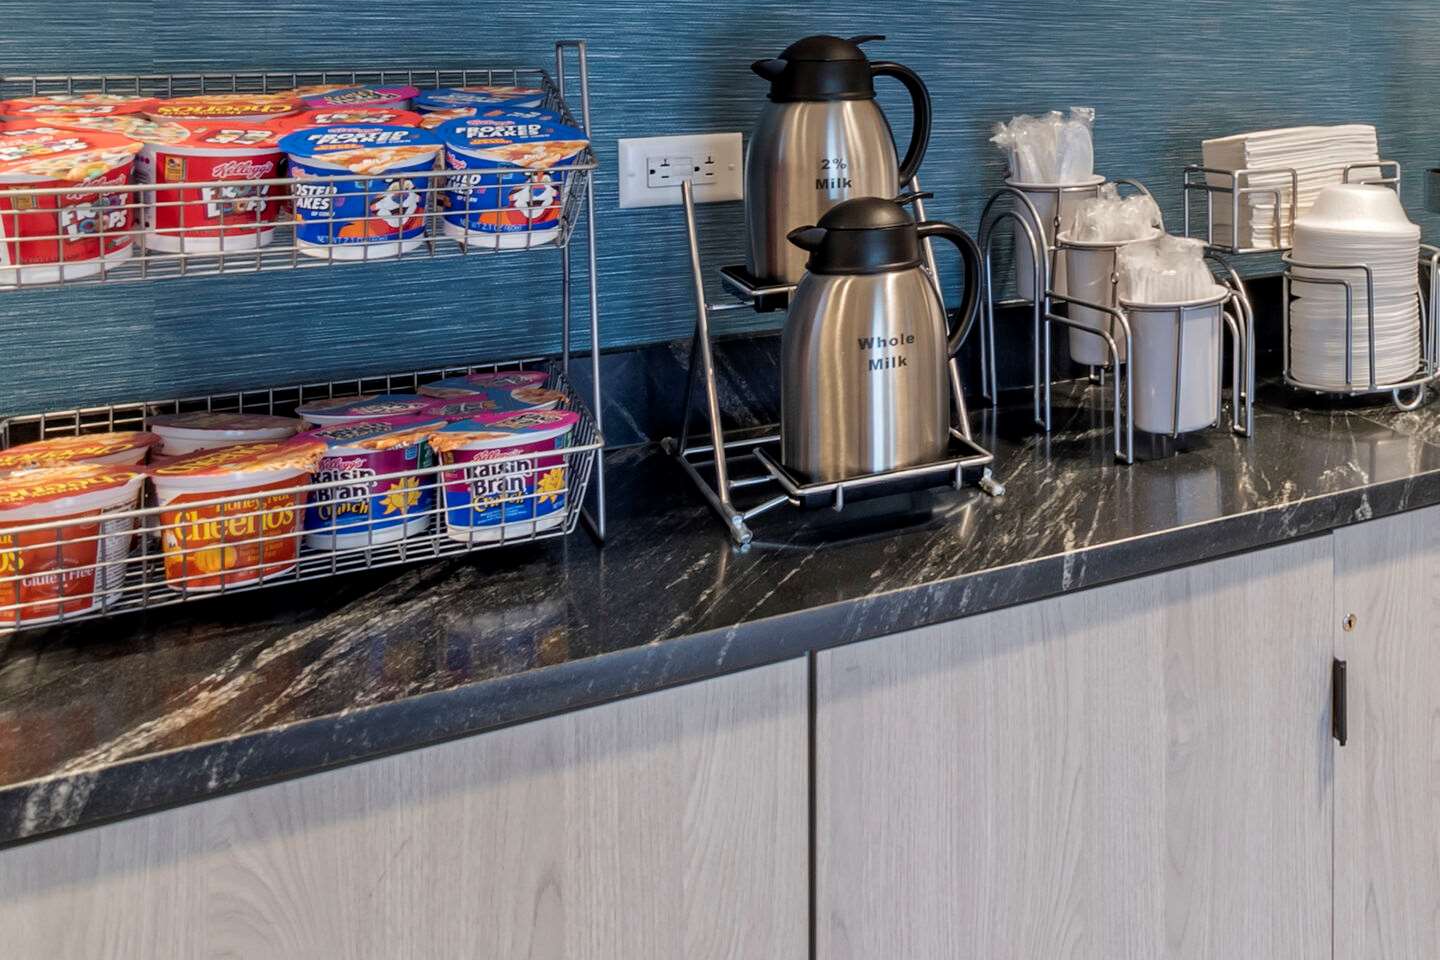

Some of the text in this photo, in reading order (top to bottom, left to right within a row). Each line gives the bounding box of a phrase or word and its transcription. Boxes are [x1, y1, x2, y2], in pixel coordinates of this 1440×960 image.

[821, 158, 848, 170] 2%
[815, 177, 852, 190] Milk
[857, 333, 915, 350] Whole
[869, 355, 907, 371] Milk
[317, 482, 370, 503] Bran
[473, 476, 528, 497] Bran
[173, 501, 294, 542] Cheerios
